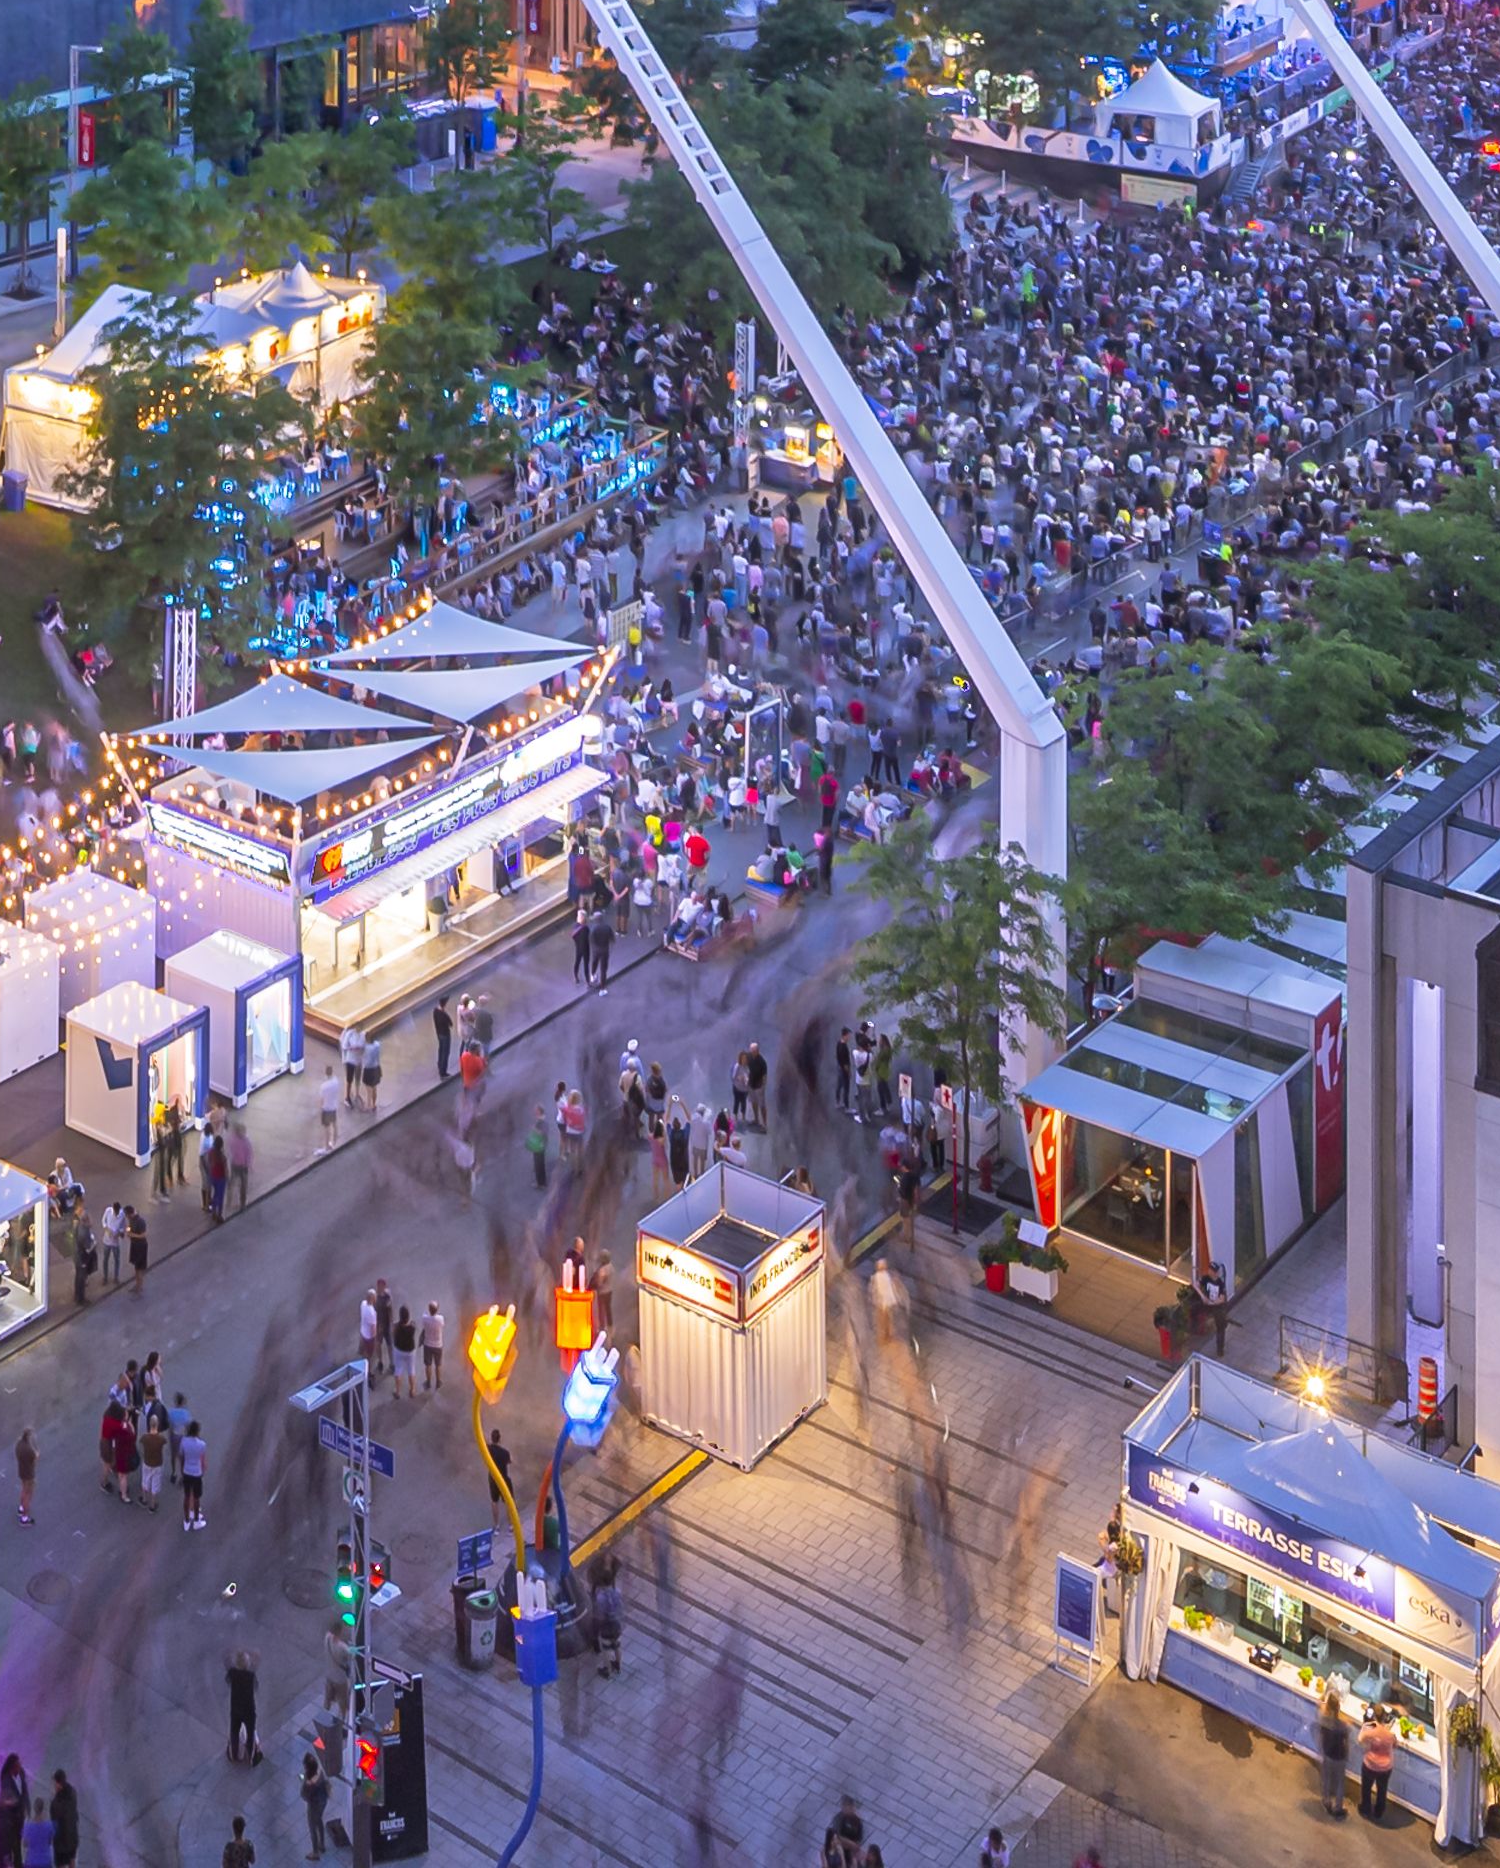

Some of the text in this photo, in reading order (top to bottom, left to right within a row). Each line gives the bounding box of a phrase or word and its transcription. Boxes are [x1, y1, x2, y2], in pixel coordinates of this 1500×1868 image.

[1209, 1499, 1374, 1593] TERRASSE ESKA
[1408, 1596, 1451, 1626] eska
